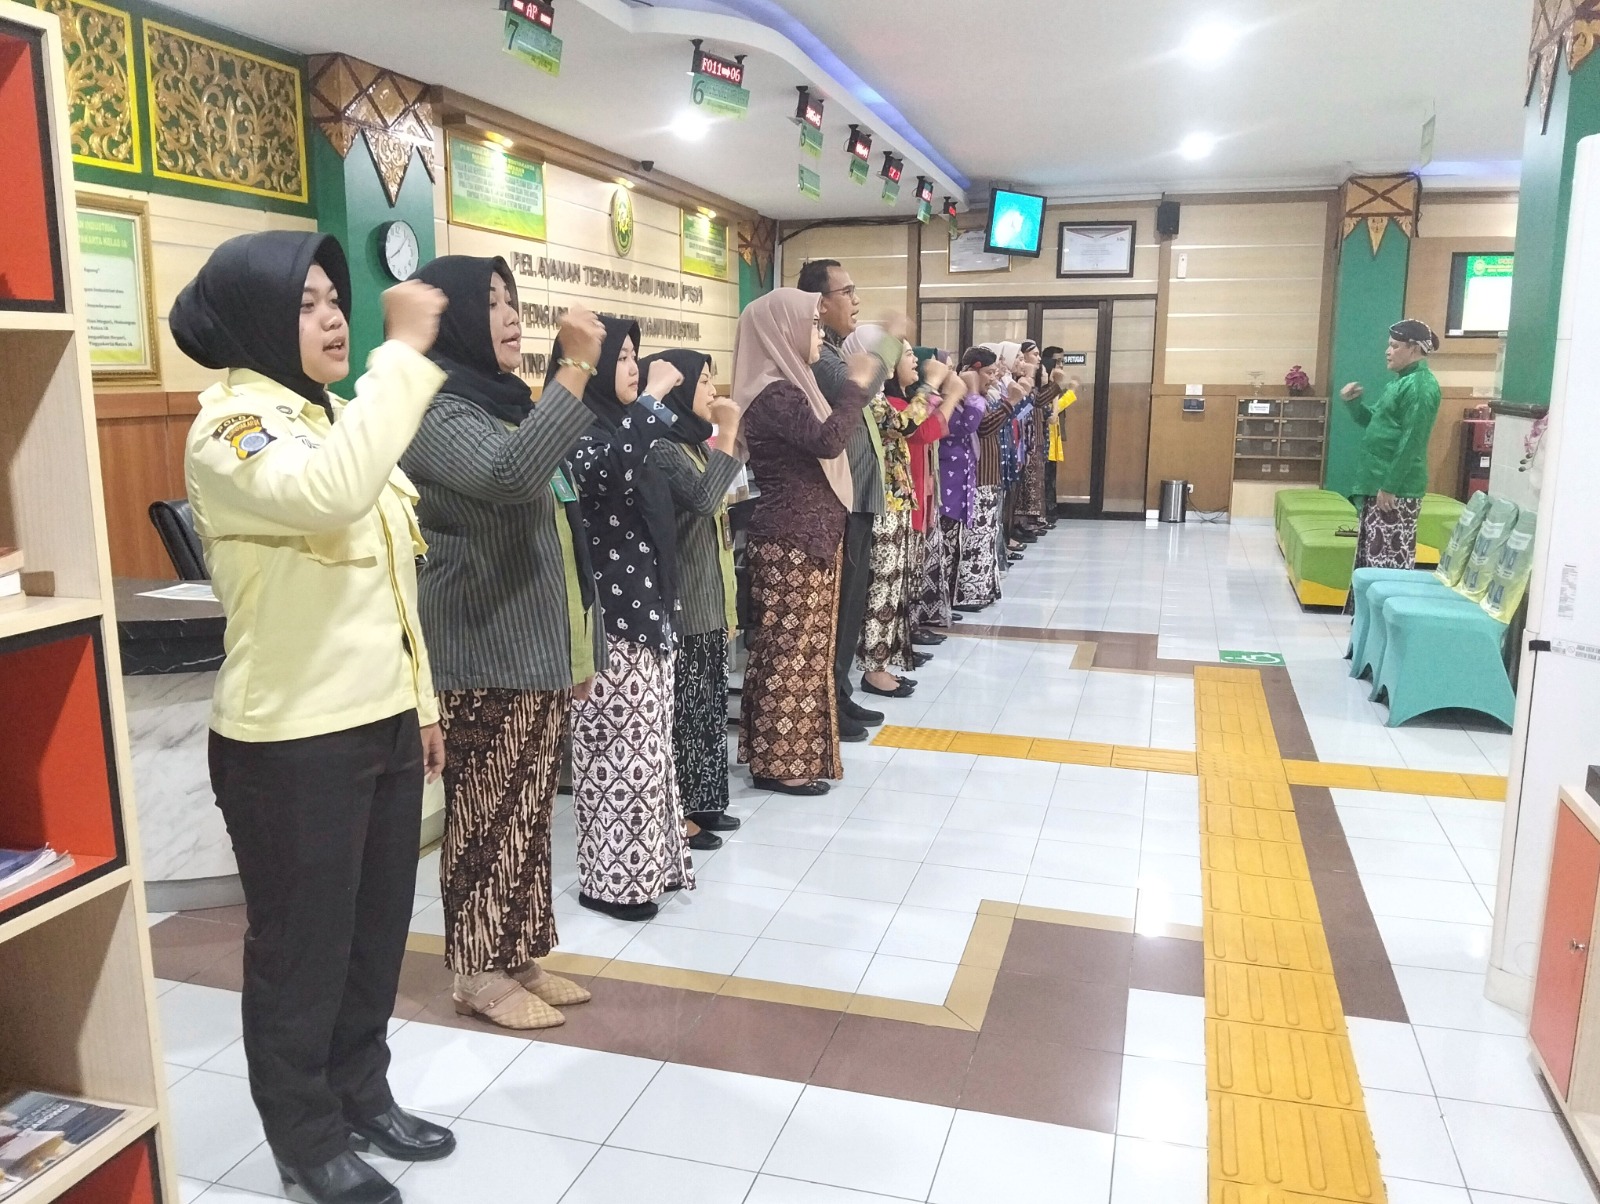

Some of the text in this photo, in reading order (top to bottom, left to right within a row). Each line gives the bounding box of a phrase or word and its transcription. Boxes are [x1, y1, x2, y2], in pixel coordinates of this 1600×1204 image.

[508, 18, 520, 50] 7
[693, 80, 705, 105] 6
[510, 251, 581, 285] PELAYANAN
[217, 415, 256, 434] POLDA
